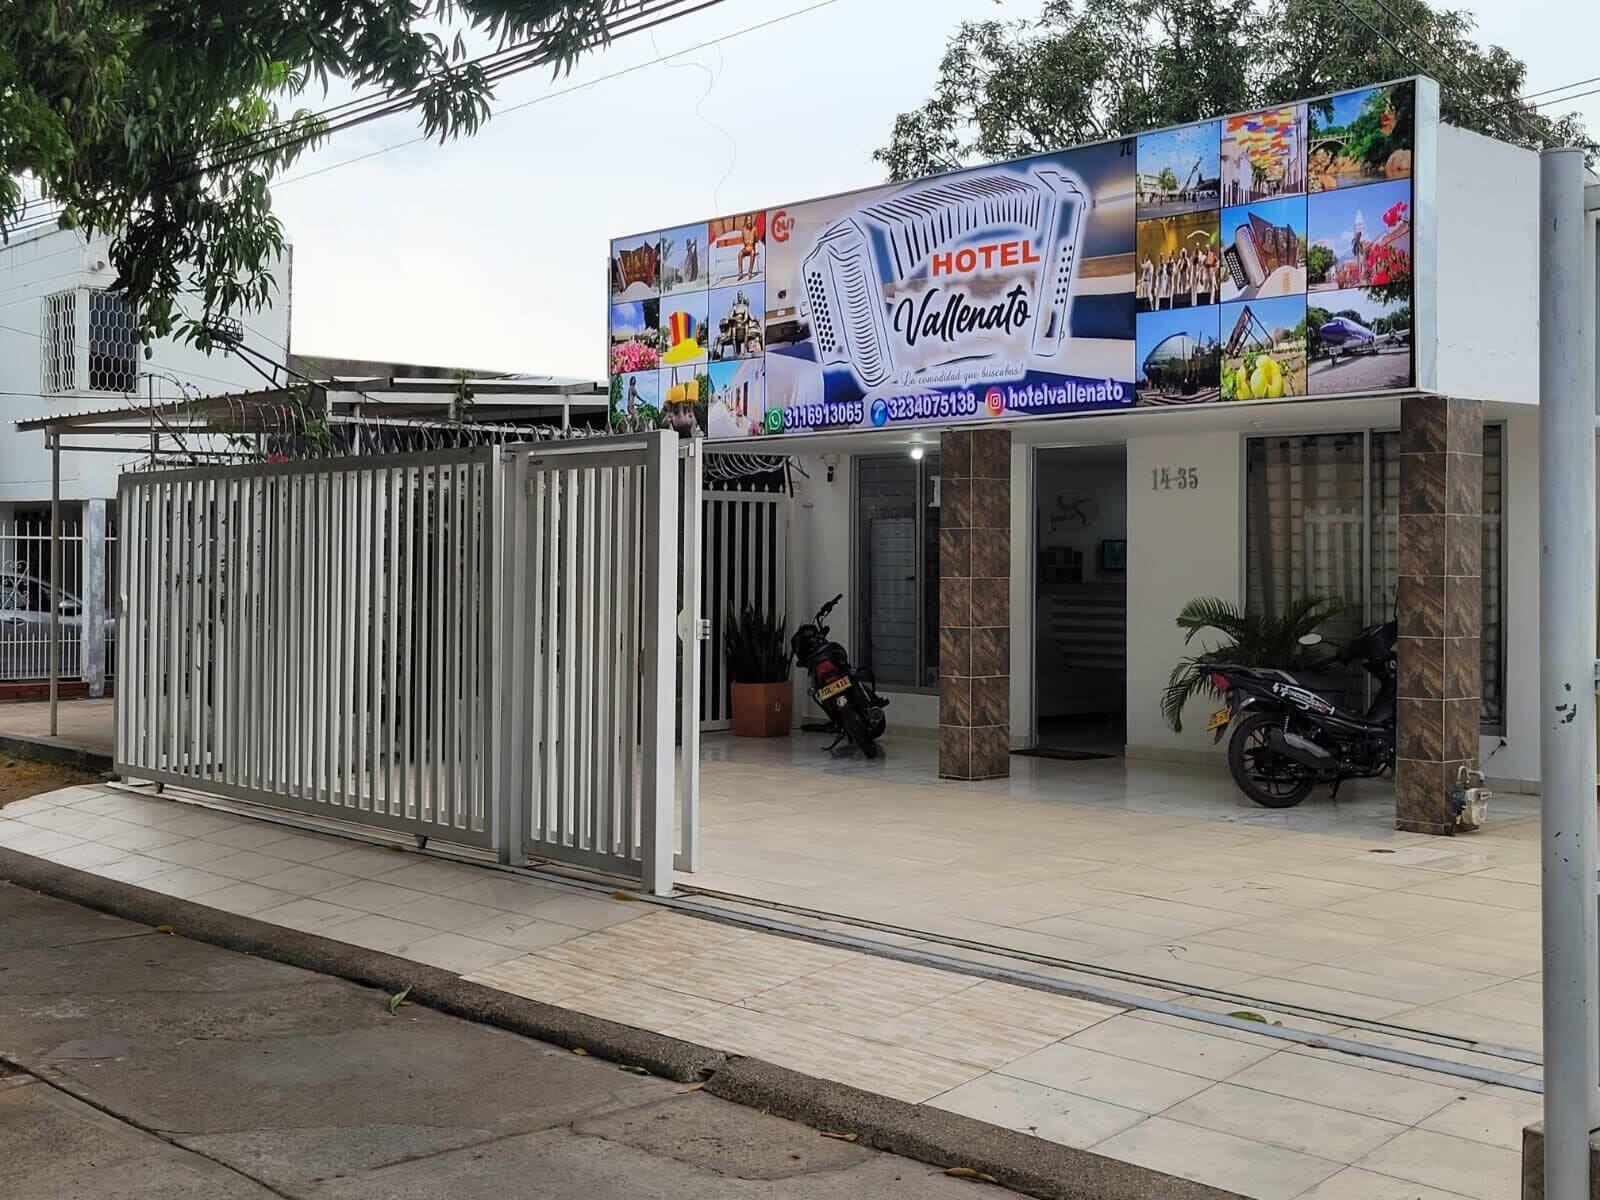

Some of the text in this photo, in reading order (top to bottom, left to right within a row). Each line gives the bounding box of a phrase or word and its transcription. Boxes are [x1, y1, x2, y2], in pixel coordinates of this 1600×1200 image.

[932, 239, 1041, 277] HOTEL
[893, 284, 1032, 347] Vallenato
[918, 369, 961, 384] comodidad
[963, 372, 977, 382] que
[981, 363, 1024, 378] buscabas!
[783, 402, 864, 428] 3116913065
[887, 391, 977, 418] 3234075138
[1151, 467, 1199, 490] 14-35
